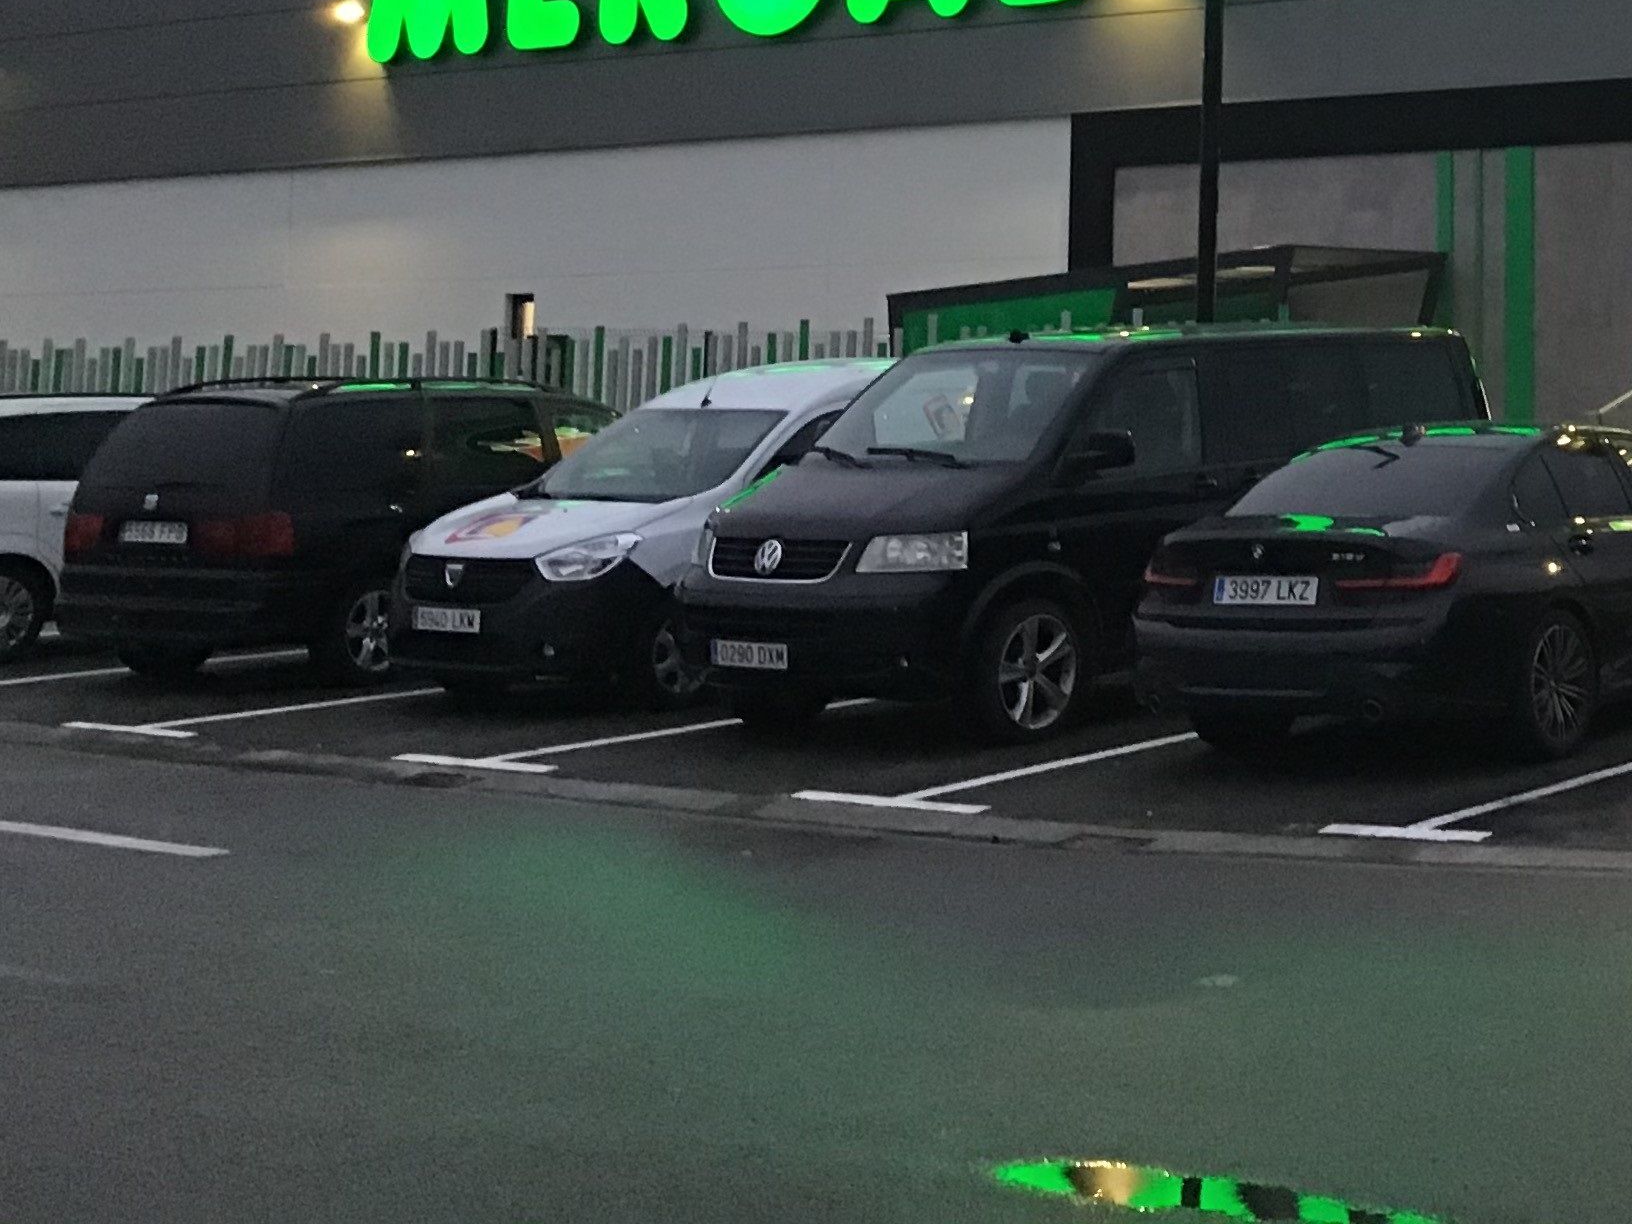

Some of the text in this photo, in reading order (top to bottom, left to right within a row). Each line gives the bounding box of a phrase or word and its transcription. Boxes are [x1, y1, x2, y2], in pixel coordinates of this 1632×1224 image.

[1228, 579, 1312, 601] 3997 LKZ
[721, 643, 755, 663] 0290
